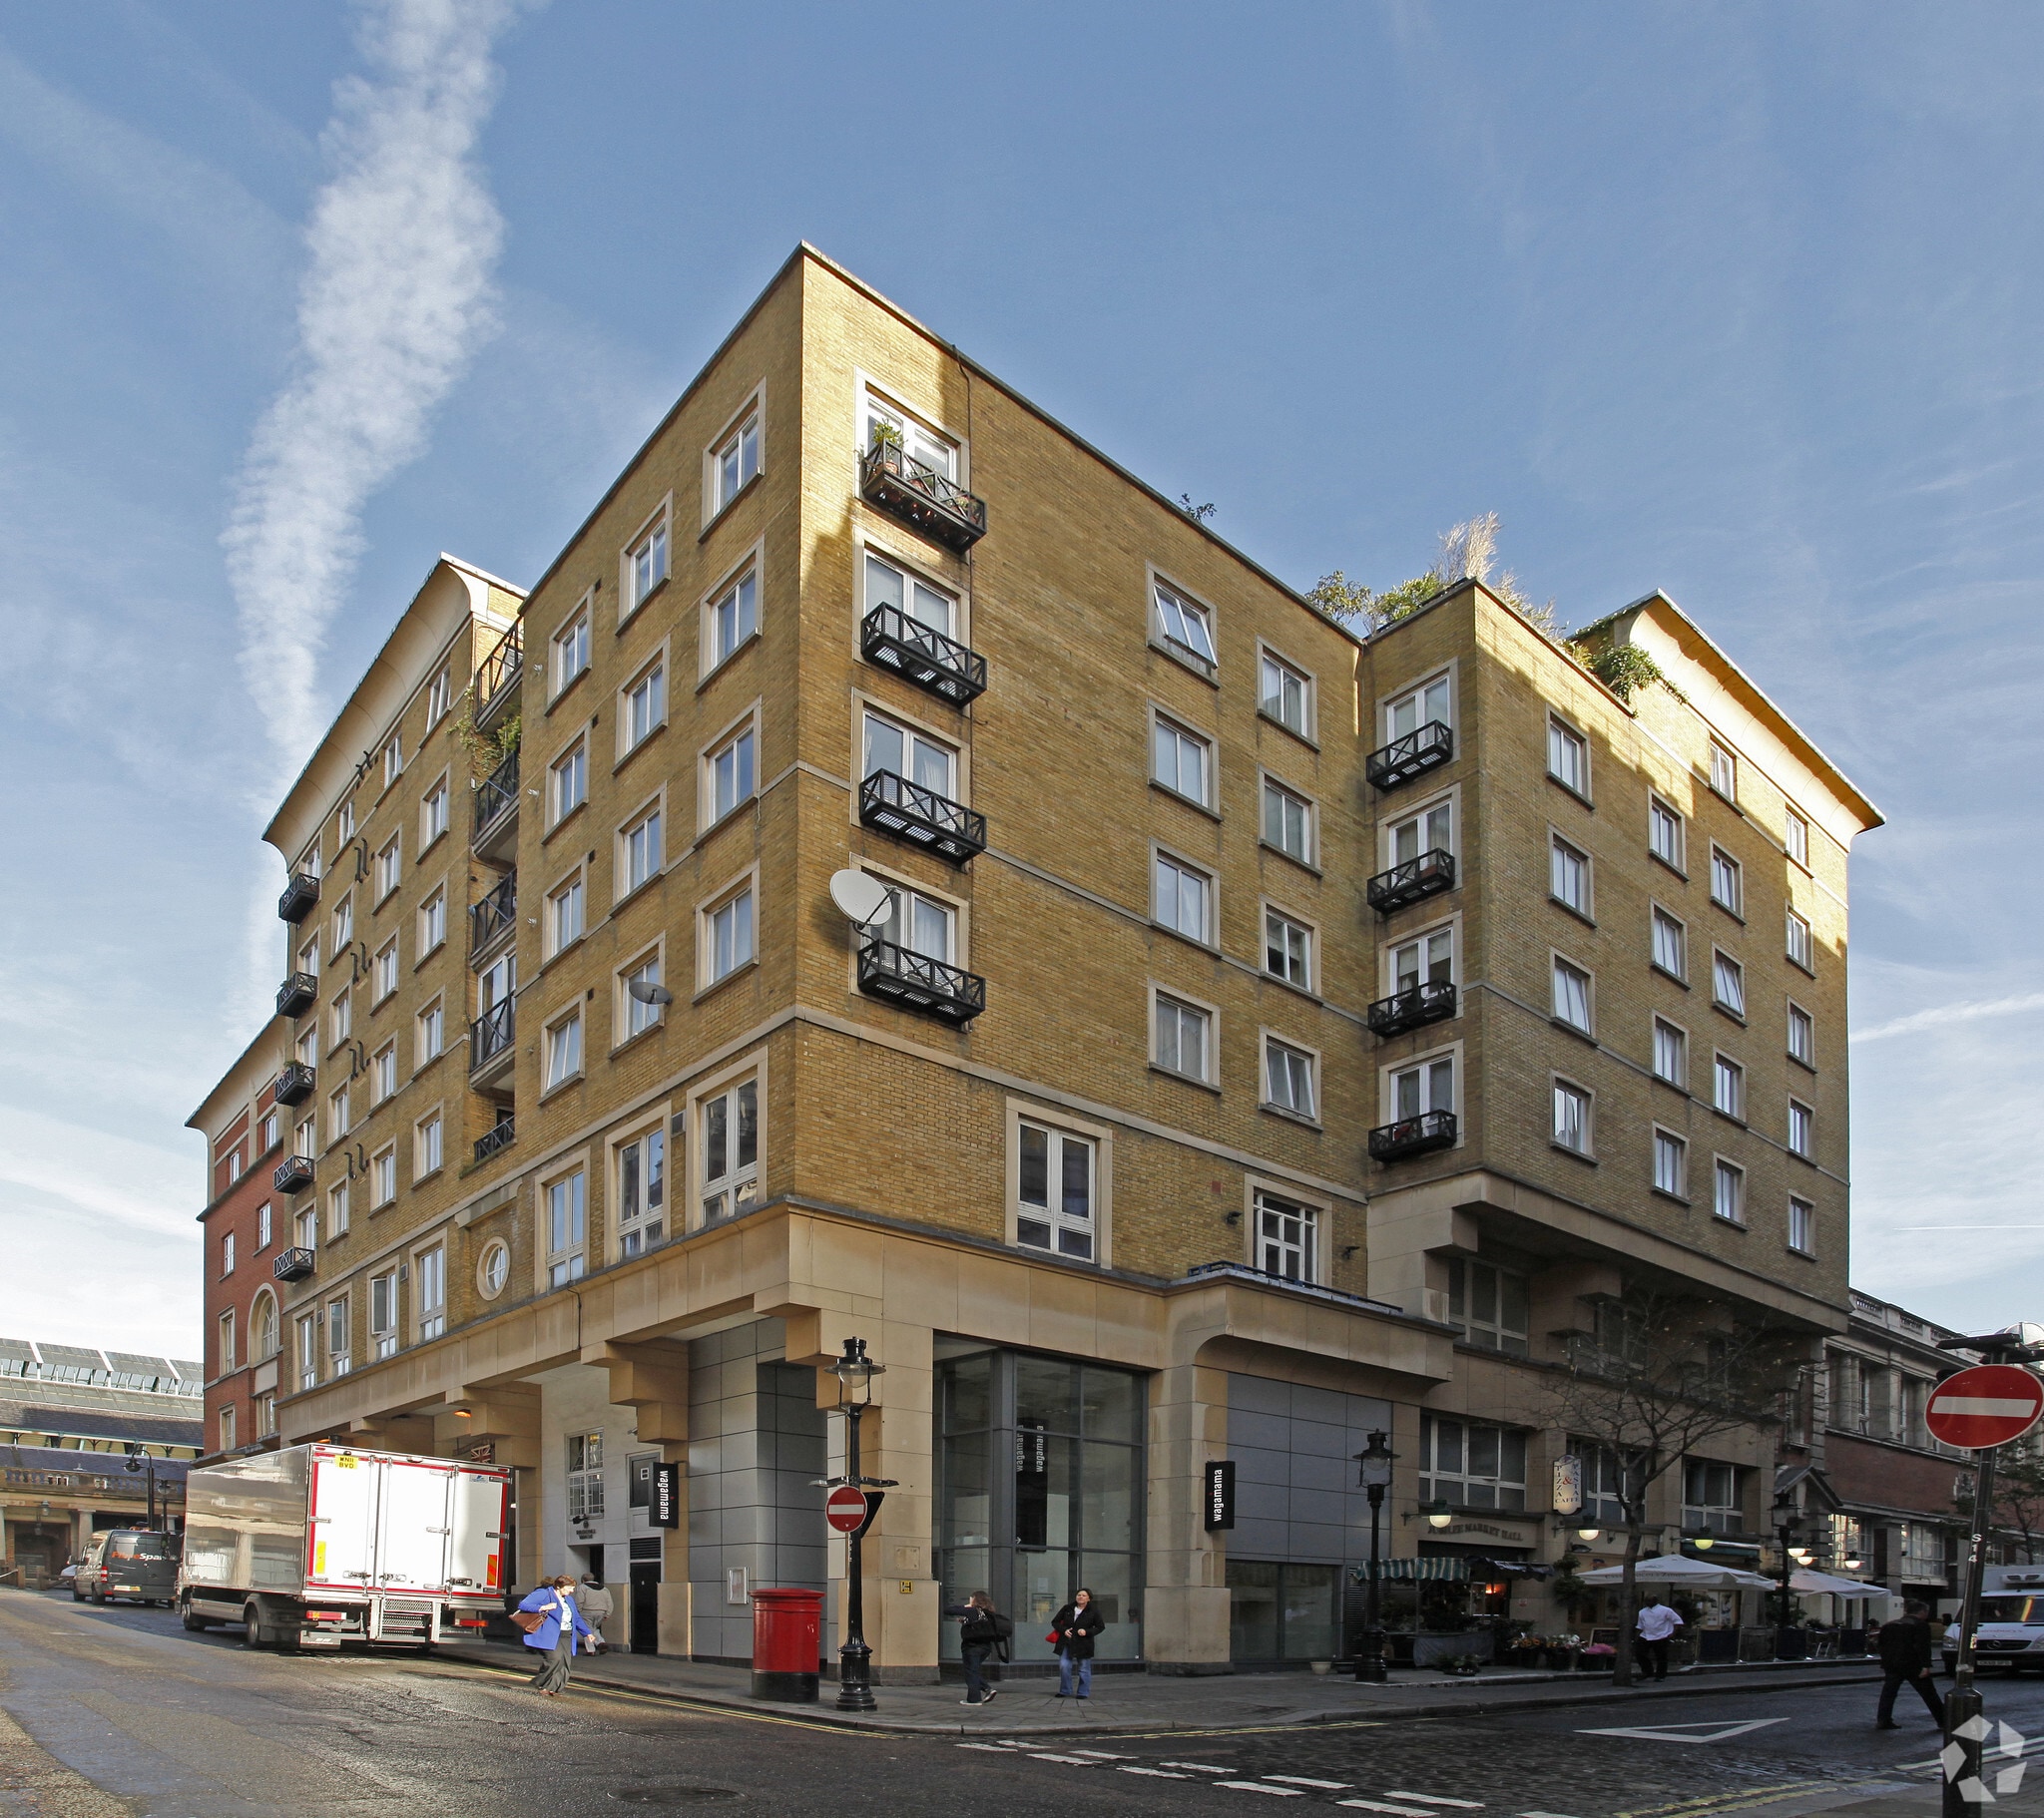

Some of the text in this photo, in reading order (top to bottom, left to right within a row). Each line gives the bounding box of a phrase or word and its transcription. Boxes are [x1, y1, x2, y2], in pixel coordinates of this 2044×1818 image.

[1036, 1425, 1045, 1472] wagamaa
[658, 1470, 669, 1520] wagamama
[1214, 1469, 1224, 1522] wagamama
[1465, 1523, 1500, 1537] MARKET
[1501, 1530, 1524, 1542] HALL
